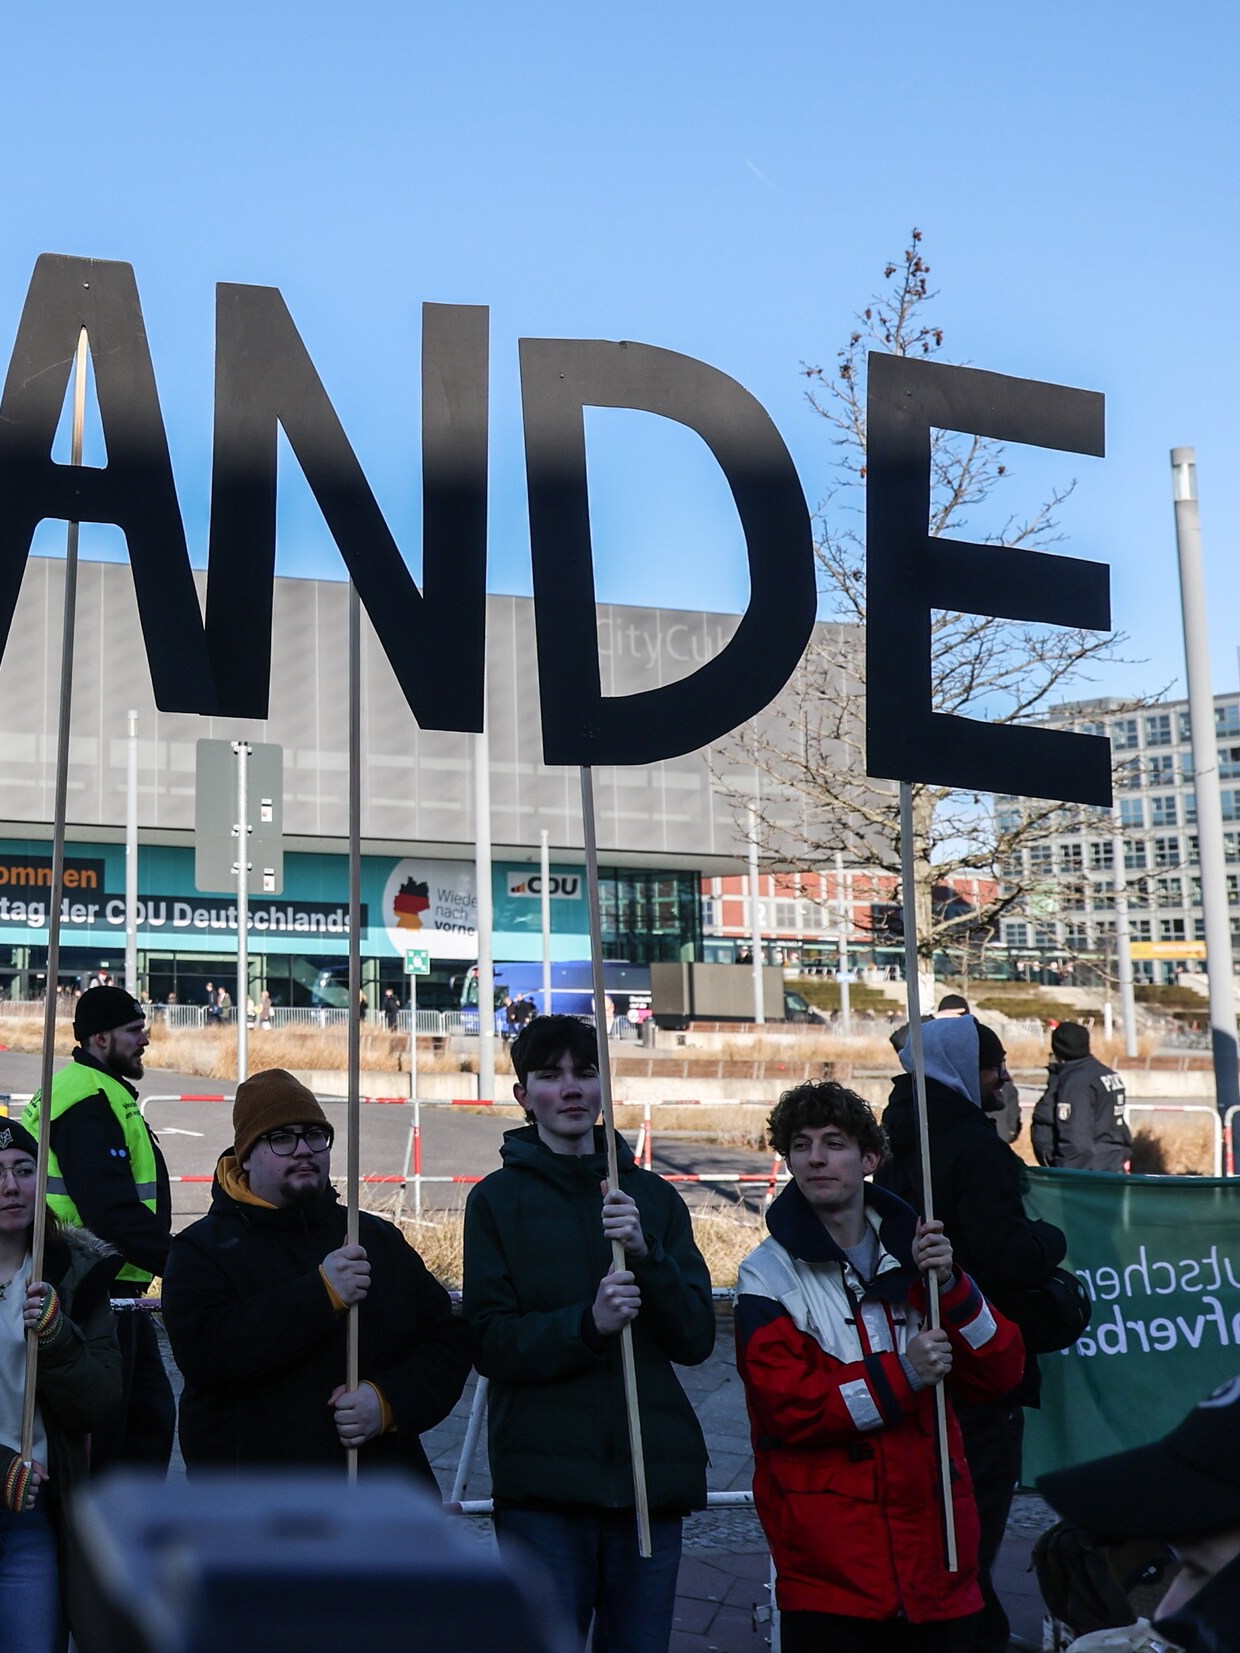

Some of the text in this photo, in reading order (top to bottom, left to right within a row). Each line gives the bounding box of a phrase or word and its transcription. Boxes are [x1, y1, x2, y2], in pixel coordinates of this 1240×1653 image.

[597, 618, 730, 668] CityCub
[437, 888, 478, 908] Wiede
[435, 906, 468, 921] nach
[434, 921, 475, 936] vorne
